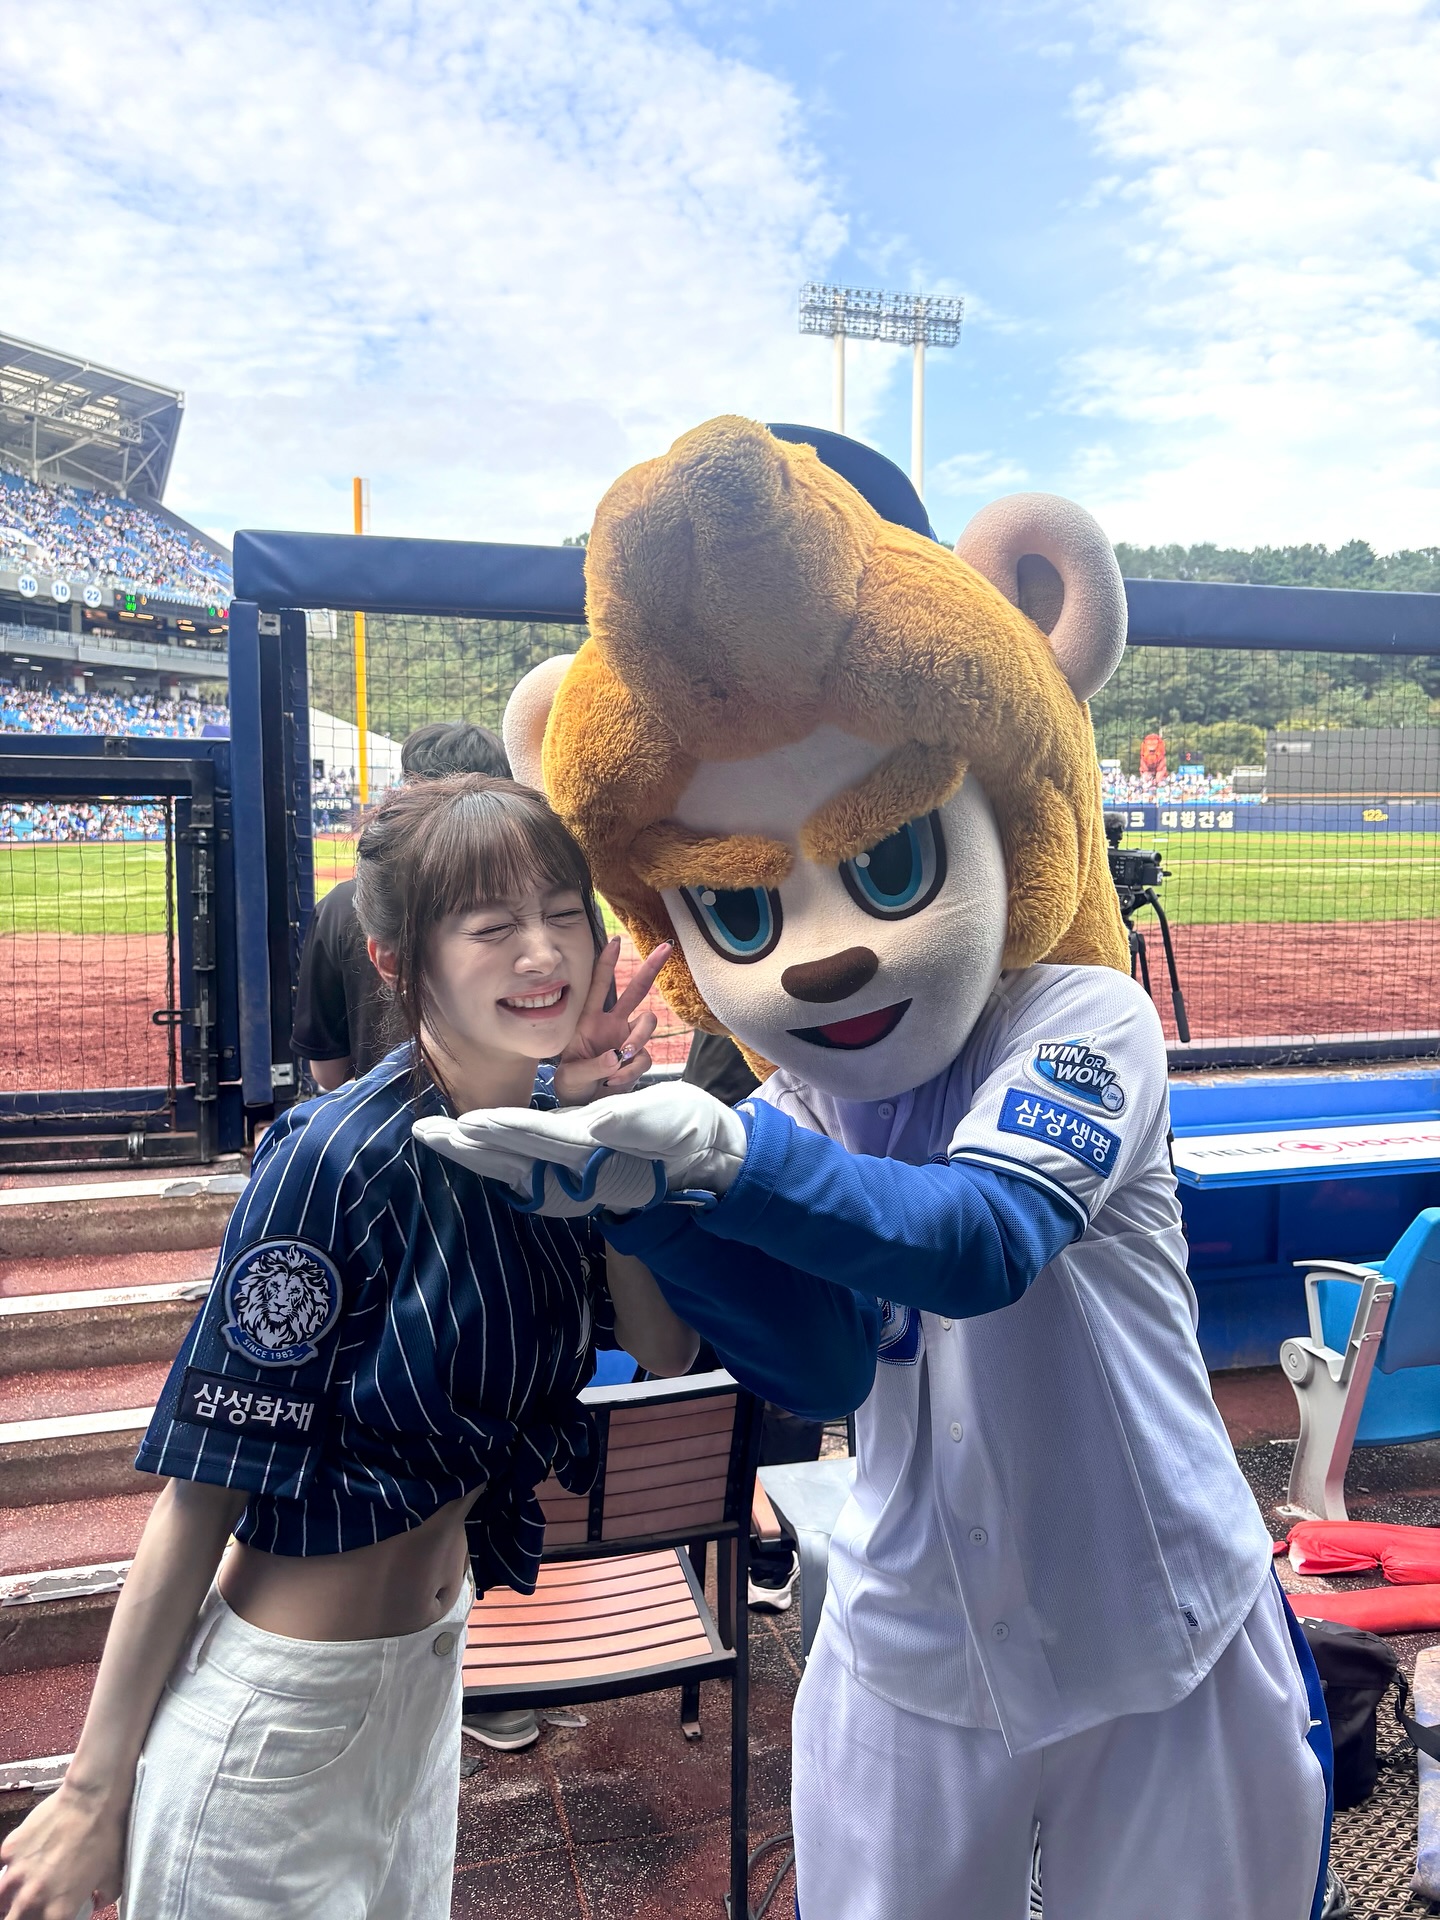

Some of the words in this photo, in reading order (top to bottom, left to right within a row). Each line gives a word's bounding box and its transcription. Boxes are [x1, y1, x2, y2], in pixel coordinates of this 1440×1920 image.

[21, 579, 36, 592] 36
[55, 585, 68, 597] 10
[86, 590, 100, 602] 22
[1040, 1046, 1087, 1063] WIN
[1084, 1057, 1103, 1068] OR
[1056, 1063, 1113, 1088] WOW
[1015, 1099, 1111, 1163] 삼성생명
[1189, 1146, 1281, 1159] FIELD
[242, 1338, 268, 1359] SINCE
[270, 1349, 295, 1360] 1982
[193, 1383, 315, 1432] 삼성화재
